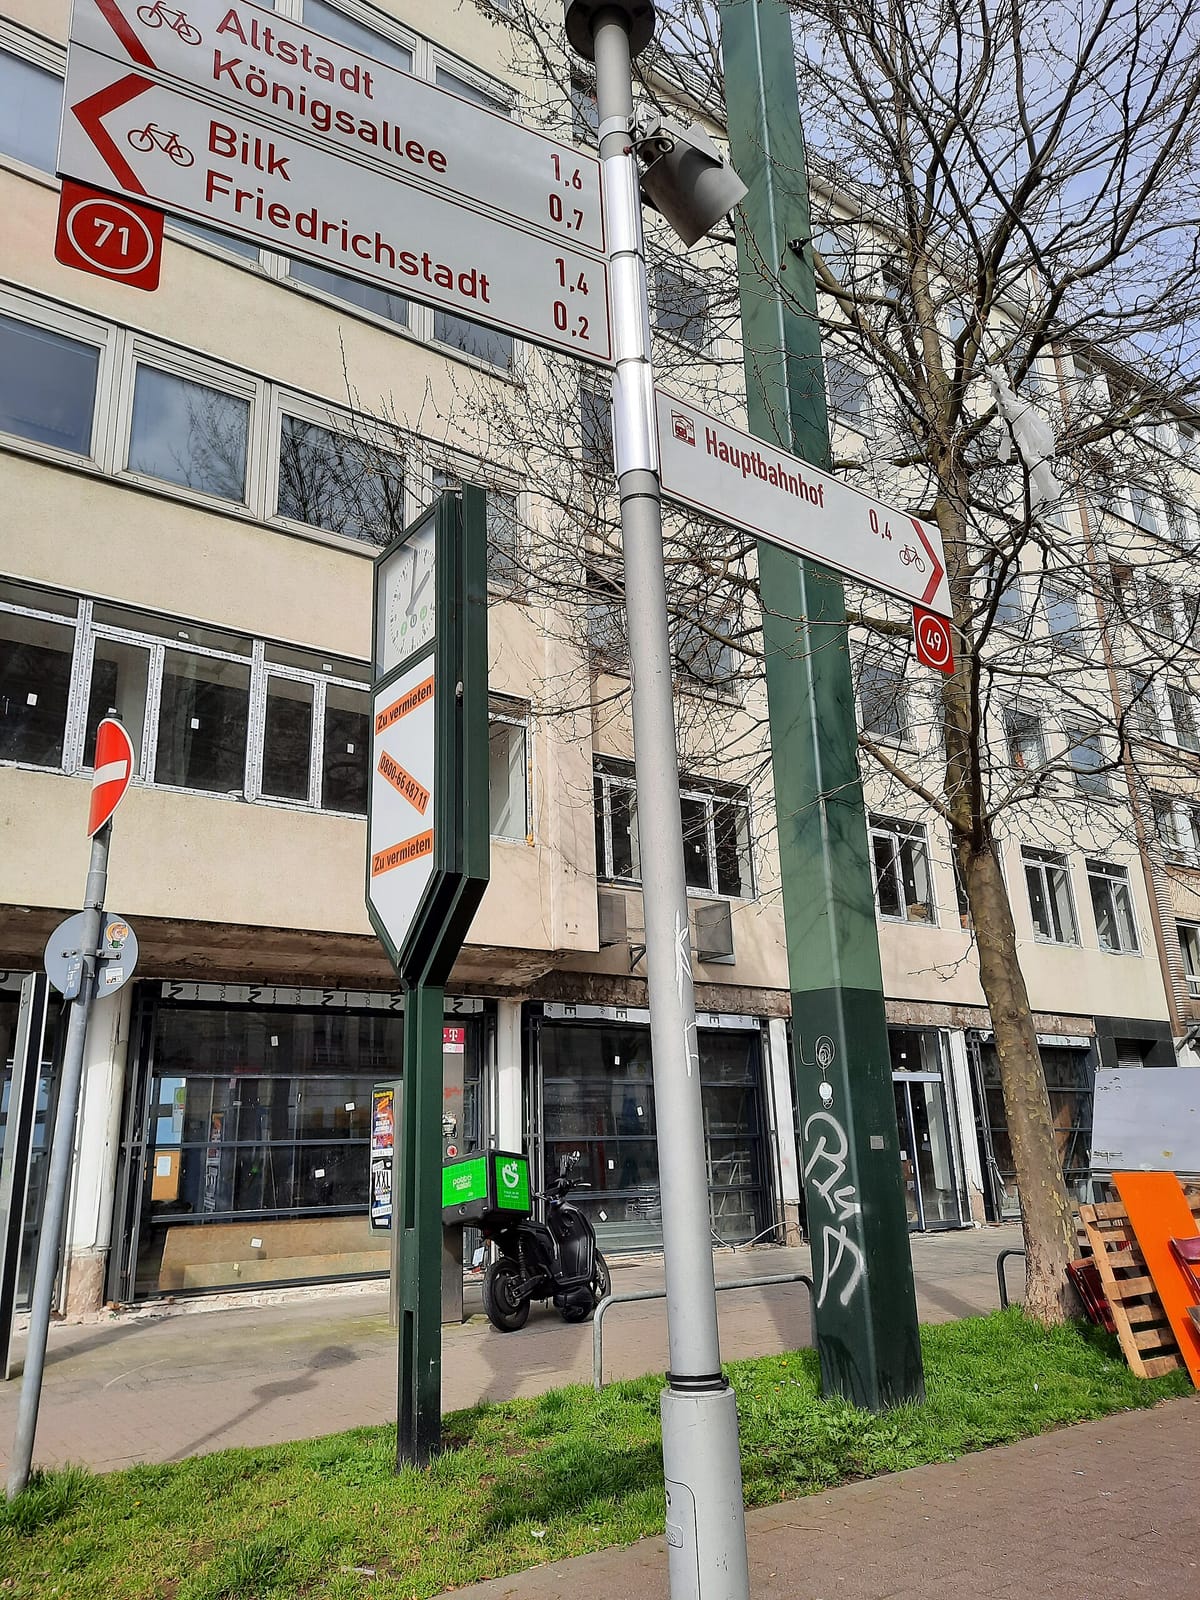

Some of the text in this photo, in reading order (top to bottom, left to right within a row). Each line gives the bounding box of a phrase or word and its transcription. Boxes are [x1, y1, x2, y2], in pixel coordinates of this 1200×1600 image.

[215, 8, 374, 100] Altstadt
[212, 49, 448, 174] Königsallee
[208, 119, 292, 182] Bilk
[93, 216, 130, 256] 71
[205, 168, 490, 303] Friedrichstadt
[704, 426, 825, 509] Hauptbahnhof
[925, 630, 942, 651] 49
[377, 682, 433, 731] Zu vermieten
[374, 836, 431, 873] Zu vermieten
[375, 1170, 391, 1189] XXL
